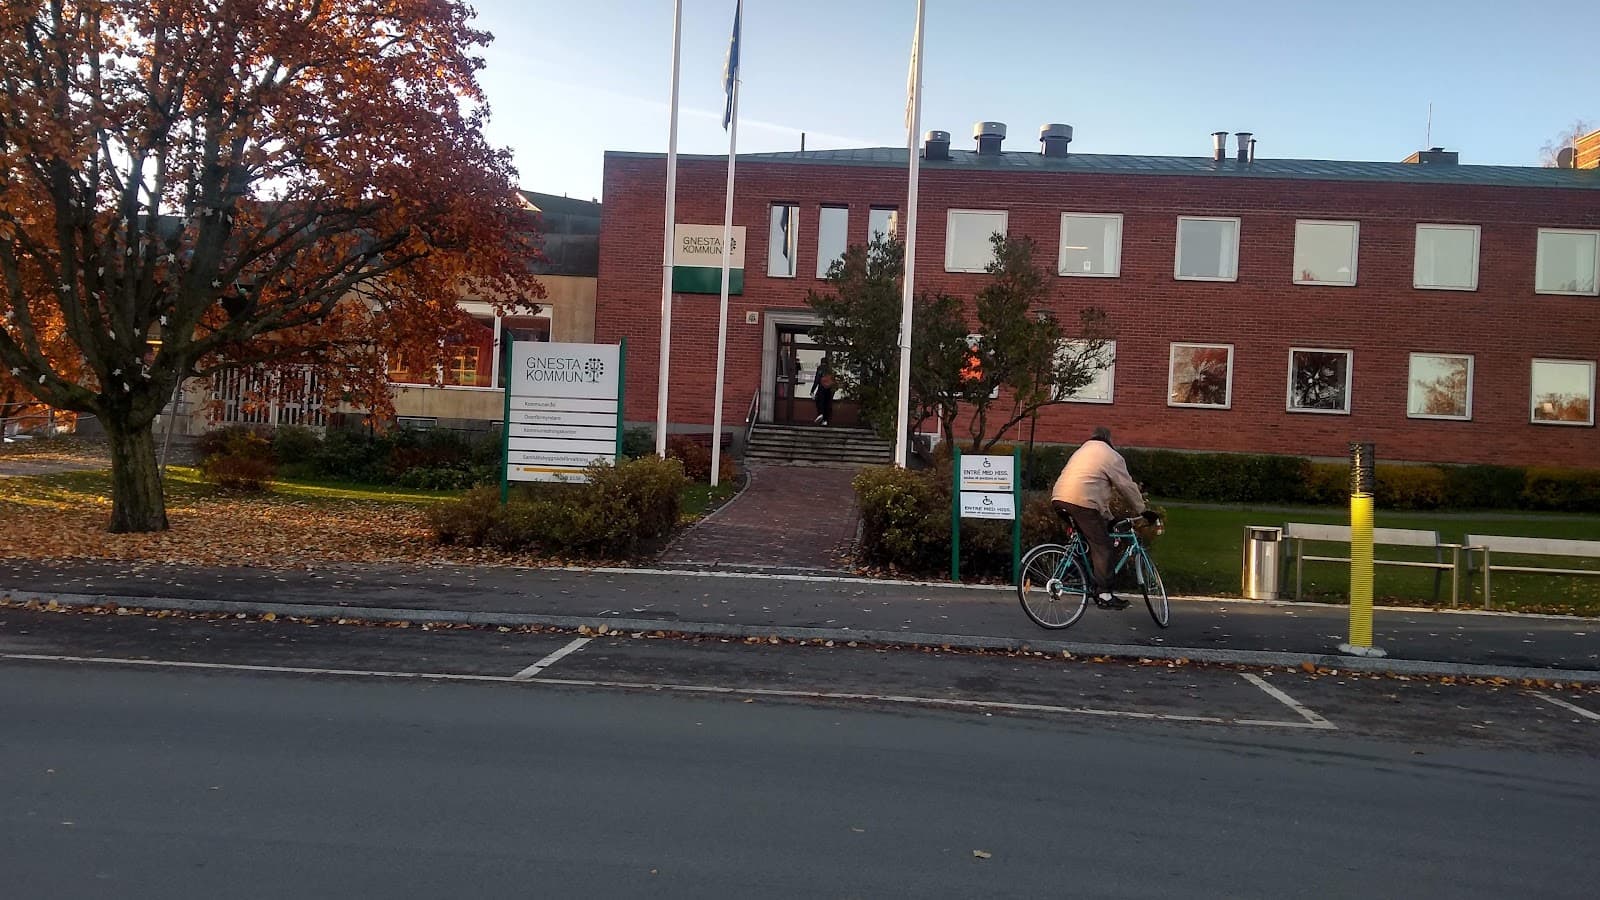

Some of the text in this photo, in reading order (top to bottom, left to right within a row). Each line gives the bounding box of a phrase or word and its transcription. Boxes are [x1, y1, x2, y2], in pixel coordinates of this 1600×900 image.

[682, 236, 721, 246] GNESTA
[682, 245, 722, 254] KOMMUN
[526, 356, 582, 370] GNESTA
[526, 369, 583, 382] KOMMUN
